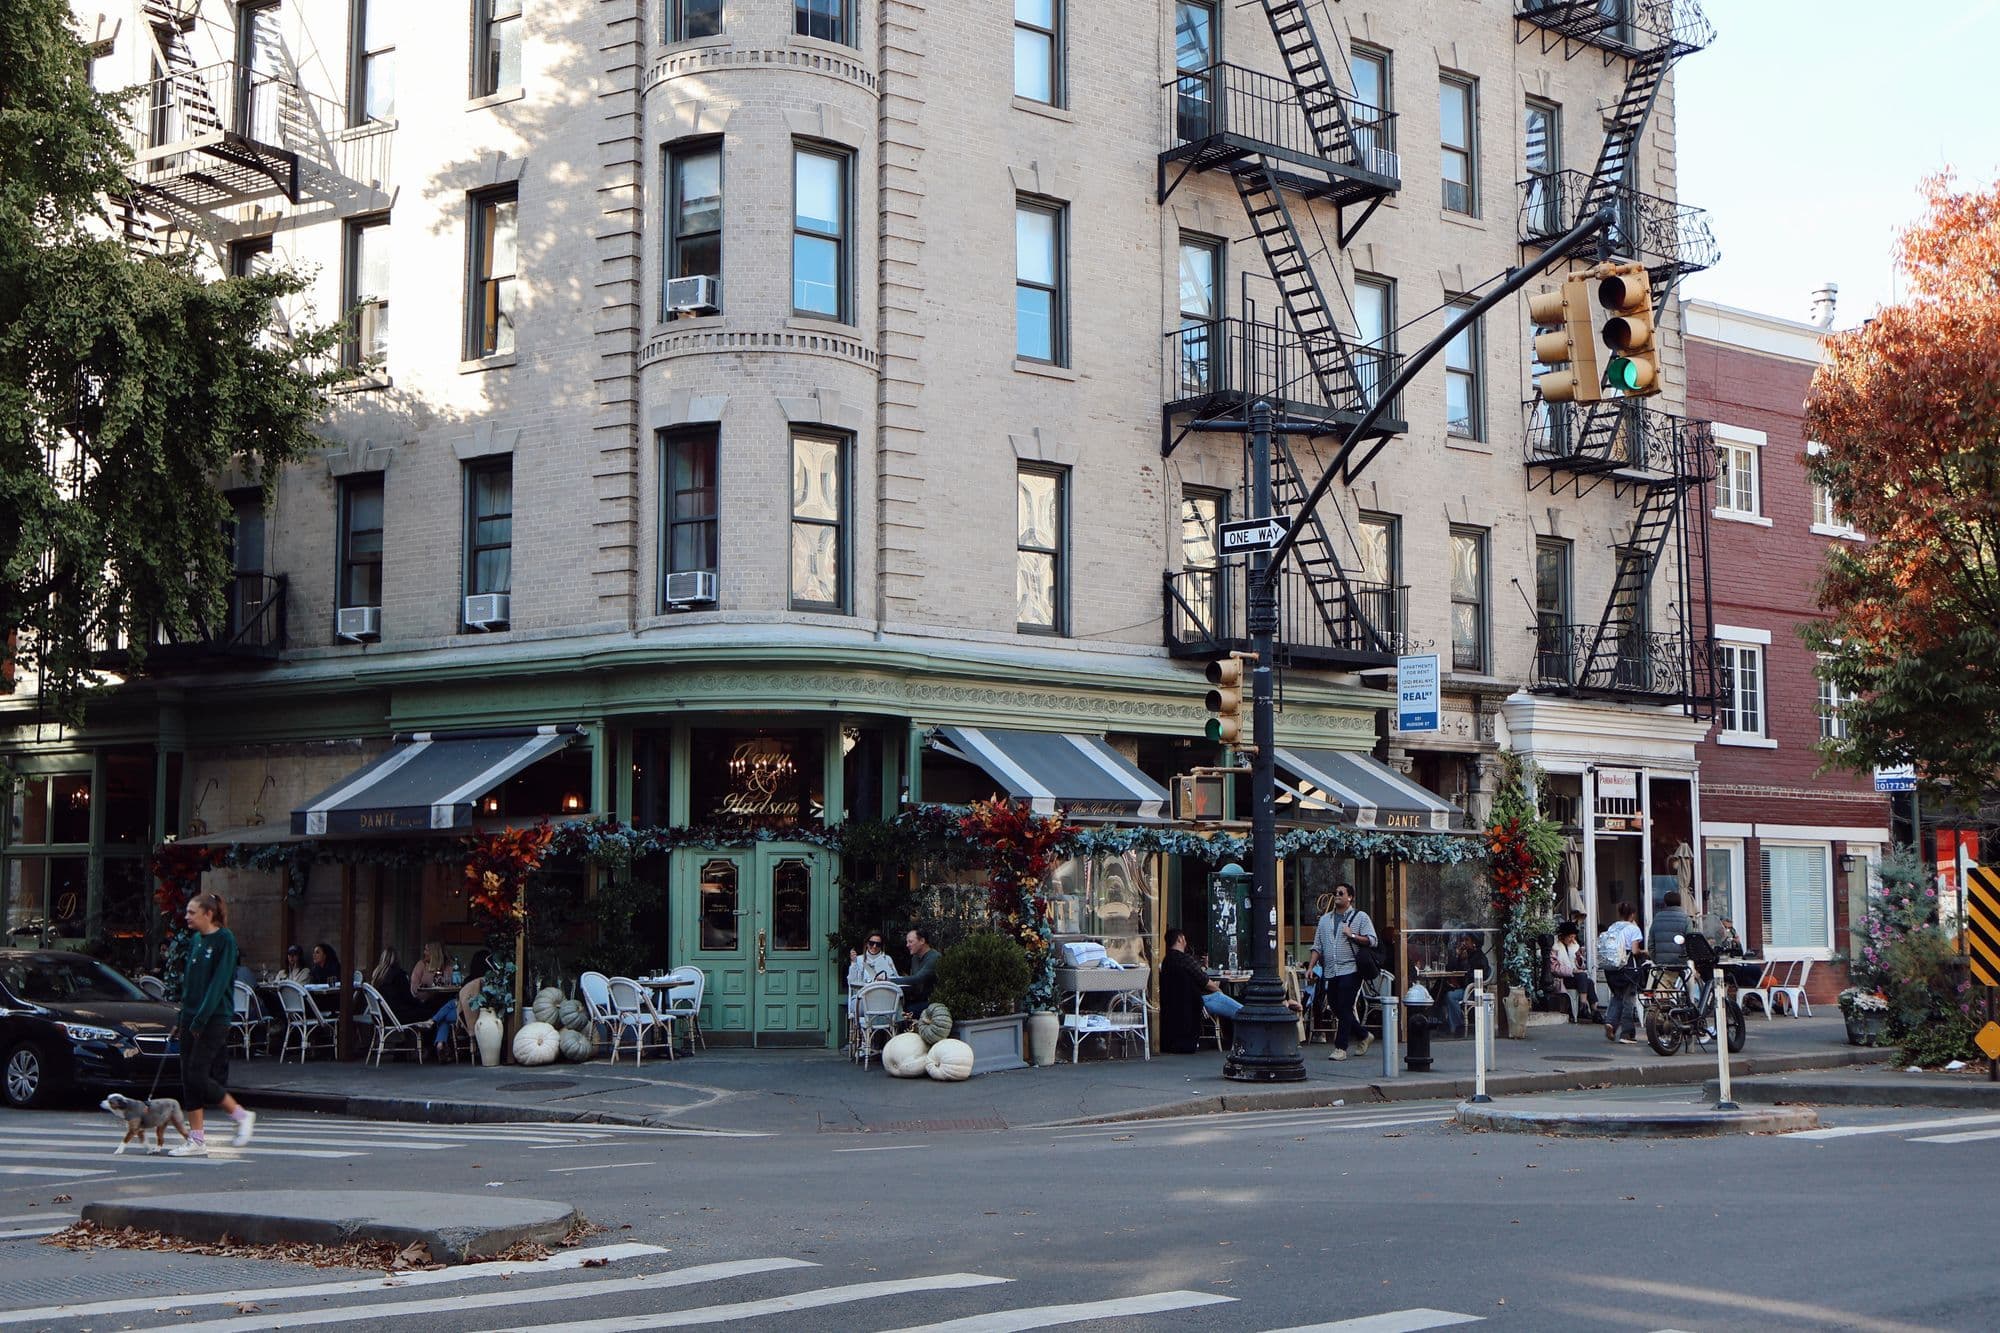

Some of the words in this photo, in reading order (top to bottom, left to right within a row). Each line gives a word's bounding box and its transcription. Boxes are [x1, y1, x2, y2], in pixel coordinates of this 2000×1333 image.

[1229, 531, 1249, 545] ONE
[1259, 528, 1280, 541] WAY
[720, 792, 800, 815] Hudson
[360, 812, 395, 828] DANTE
[1388, 814, 1420, 828] DANTE
